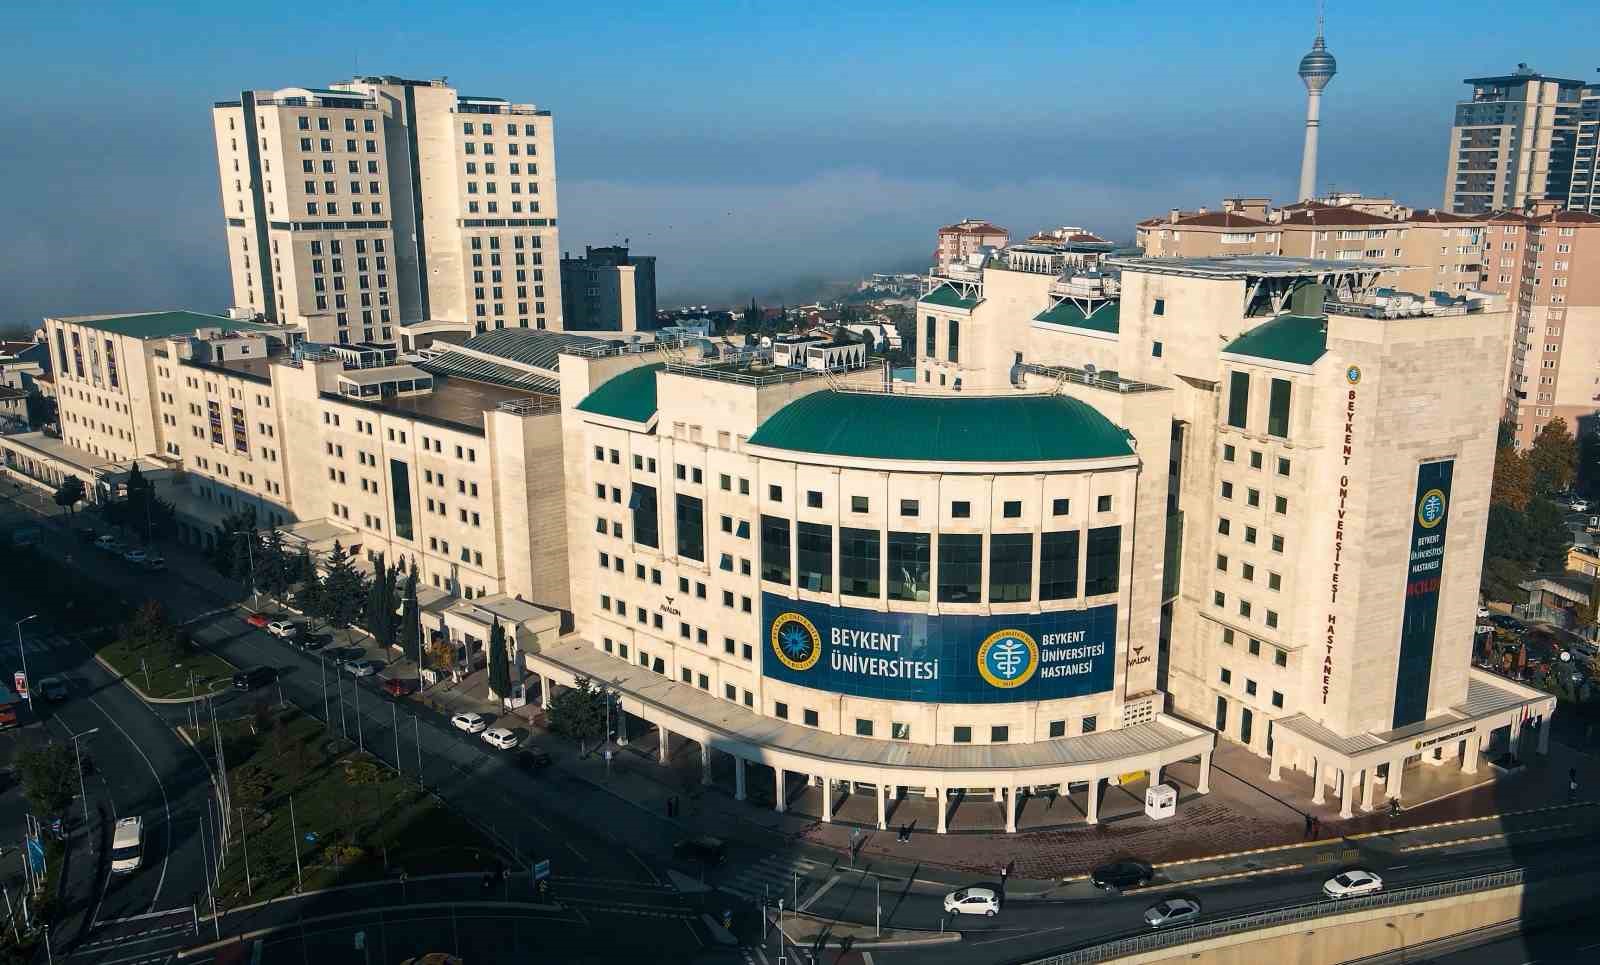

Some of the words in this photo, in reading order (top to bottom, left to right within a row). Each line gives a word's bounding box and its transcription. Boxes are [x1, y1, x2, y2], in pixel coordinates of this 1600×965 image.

[1343, 390, 1356, 466] BEYKENT
[831, 627, 903, 652] BEYKENT
[1042, 630, 1087, 646] BEYKENT
[1041, 641, 1105, 662] ÜNİVERSİTESİ
[831, 649, 939, 680] ÜNİVERSİTESİ
[1041, 659, 1093, 679] HASTANESİ
